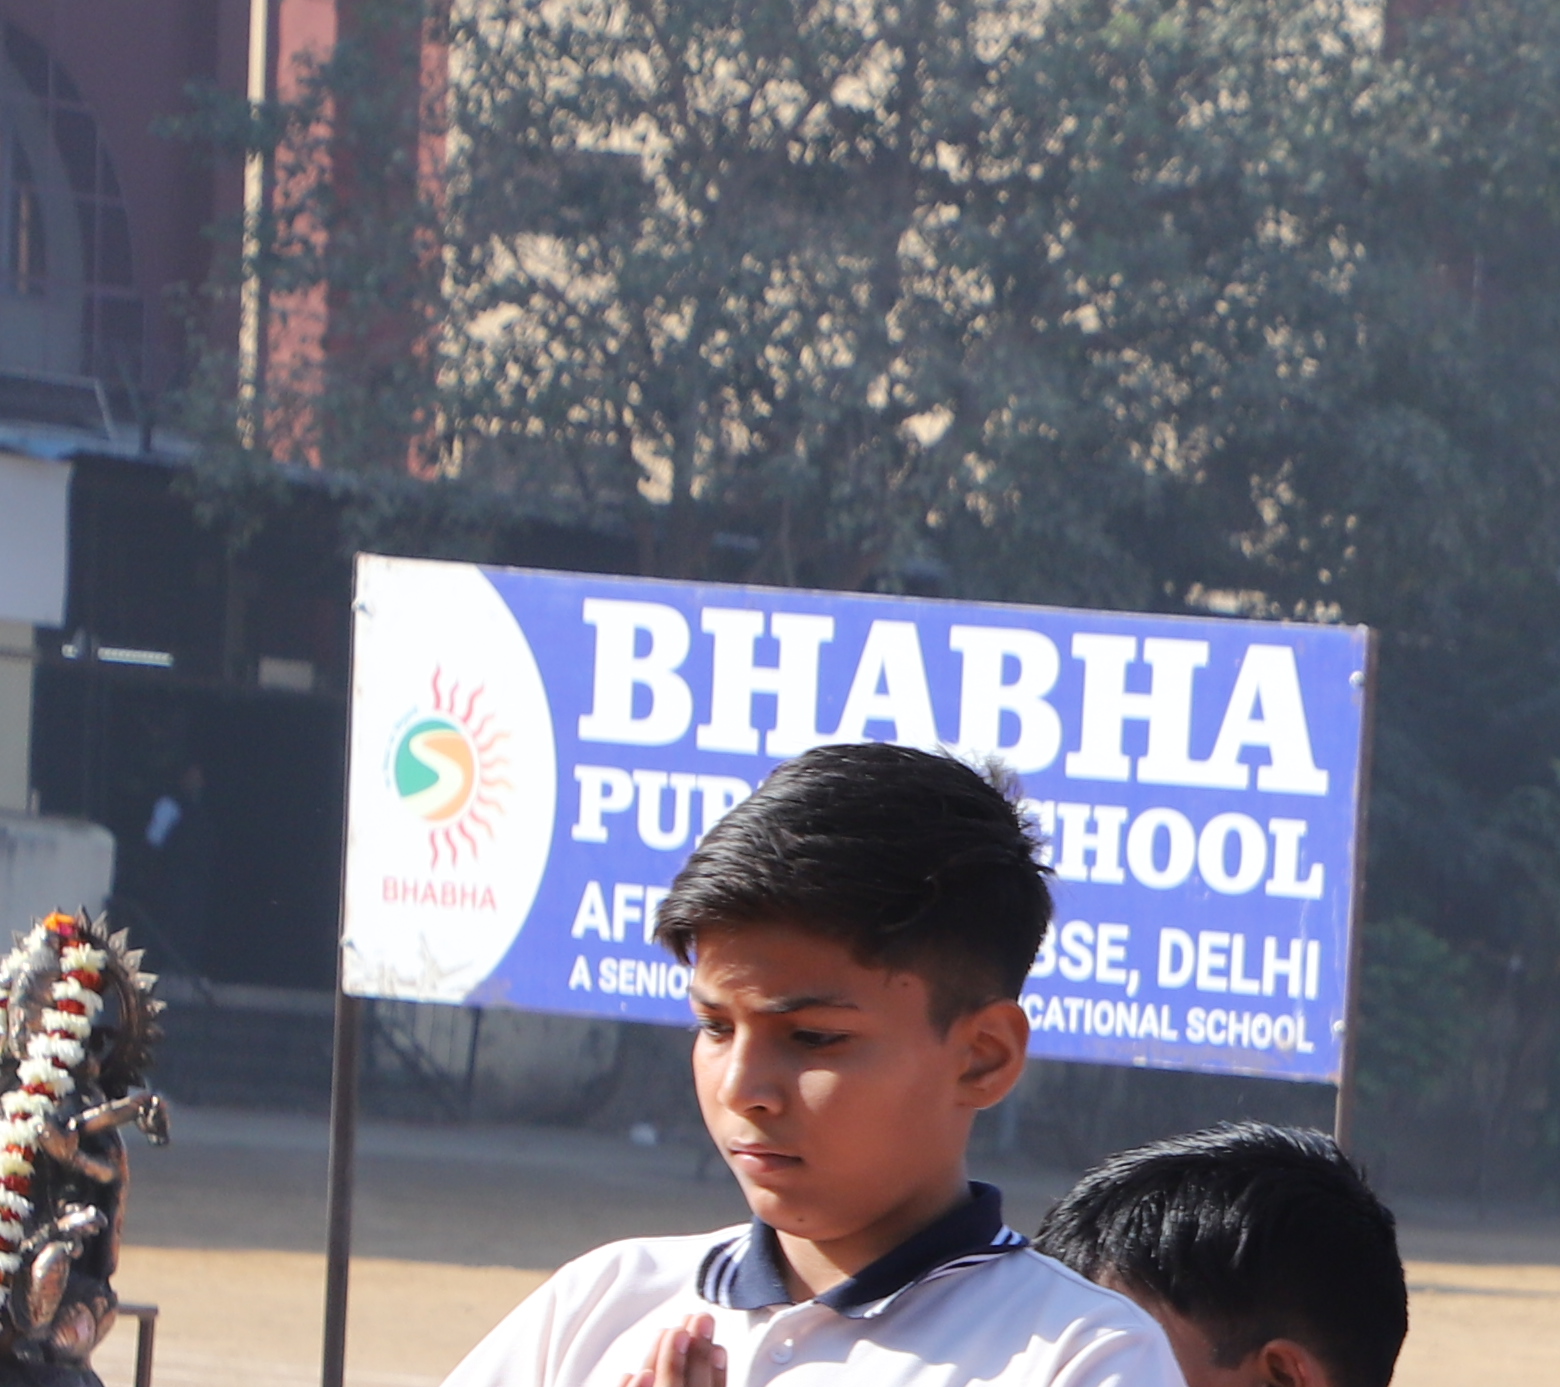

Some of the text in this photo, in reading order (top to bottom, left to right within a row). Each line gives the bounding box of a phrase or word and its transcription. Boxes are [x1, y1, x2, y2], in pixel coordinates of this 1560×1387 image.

[578, 597, 1329, 796] BHABHA
[571, 763, 764, 851] PUB
[382, 875, 497, 912] BHABHA
[1028, 920, 1320, 1000] BSE, DELHI
[568, 955, 1314, 1054] A SENIO CATIONAL SCHOOL
